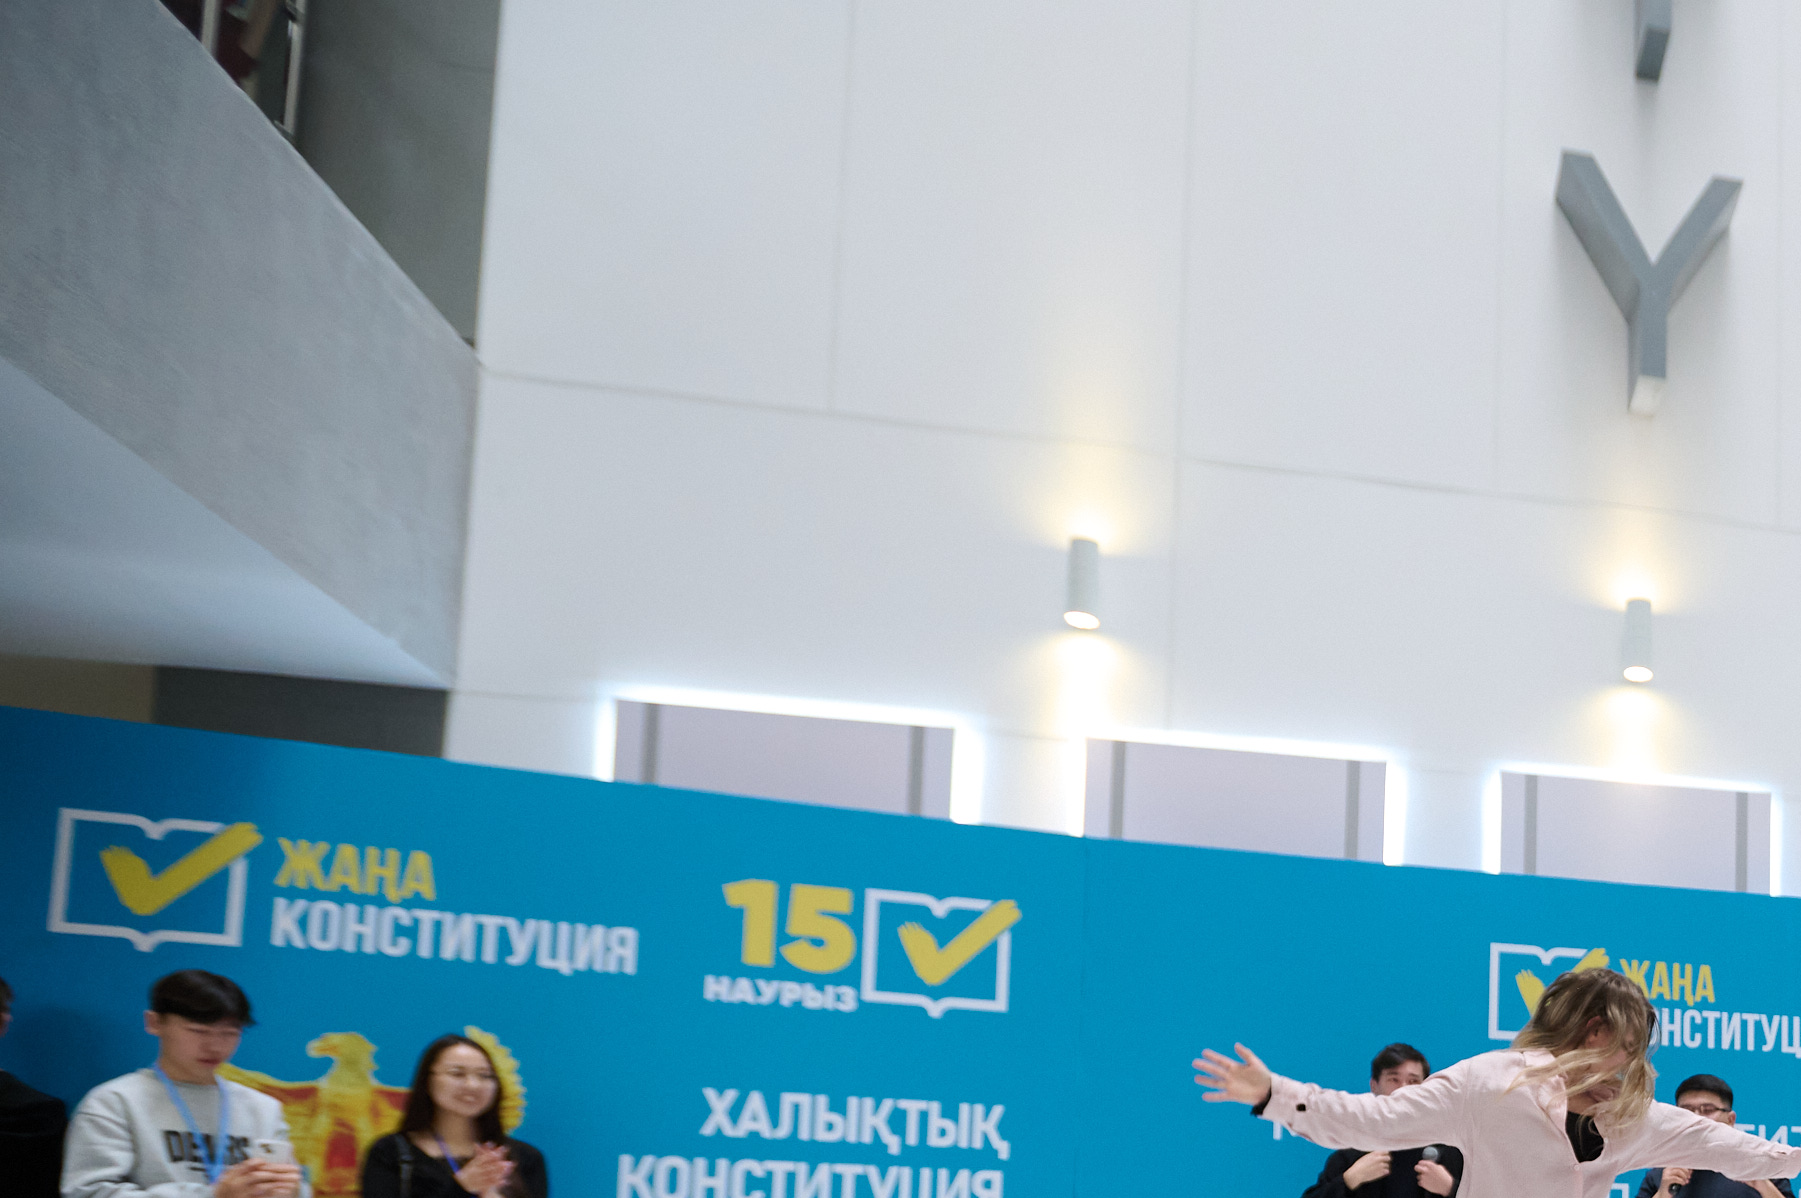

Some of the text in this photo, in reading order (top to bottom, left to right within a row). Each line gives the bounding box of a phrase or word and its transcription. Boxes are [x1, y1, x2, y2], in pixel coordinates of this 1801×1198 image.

[274, 837, 436, 903] ЖАҢА
[270, 898, 640, 977] КОНСТИТУЦИЯ
[722, 878, 857, 974] 15
[703, 974, 860, 1013] НАУРЫЗ
[698, 1087, 1011, 1162] ХАЛЫҚТЫҚ
